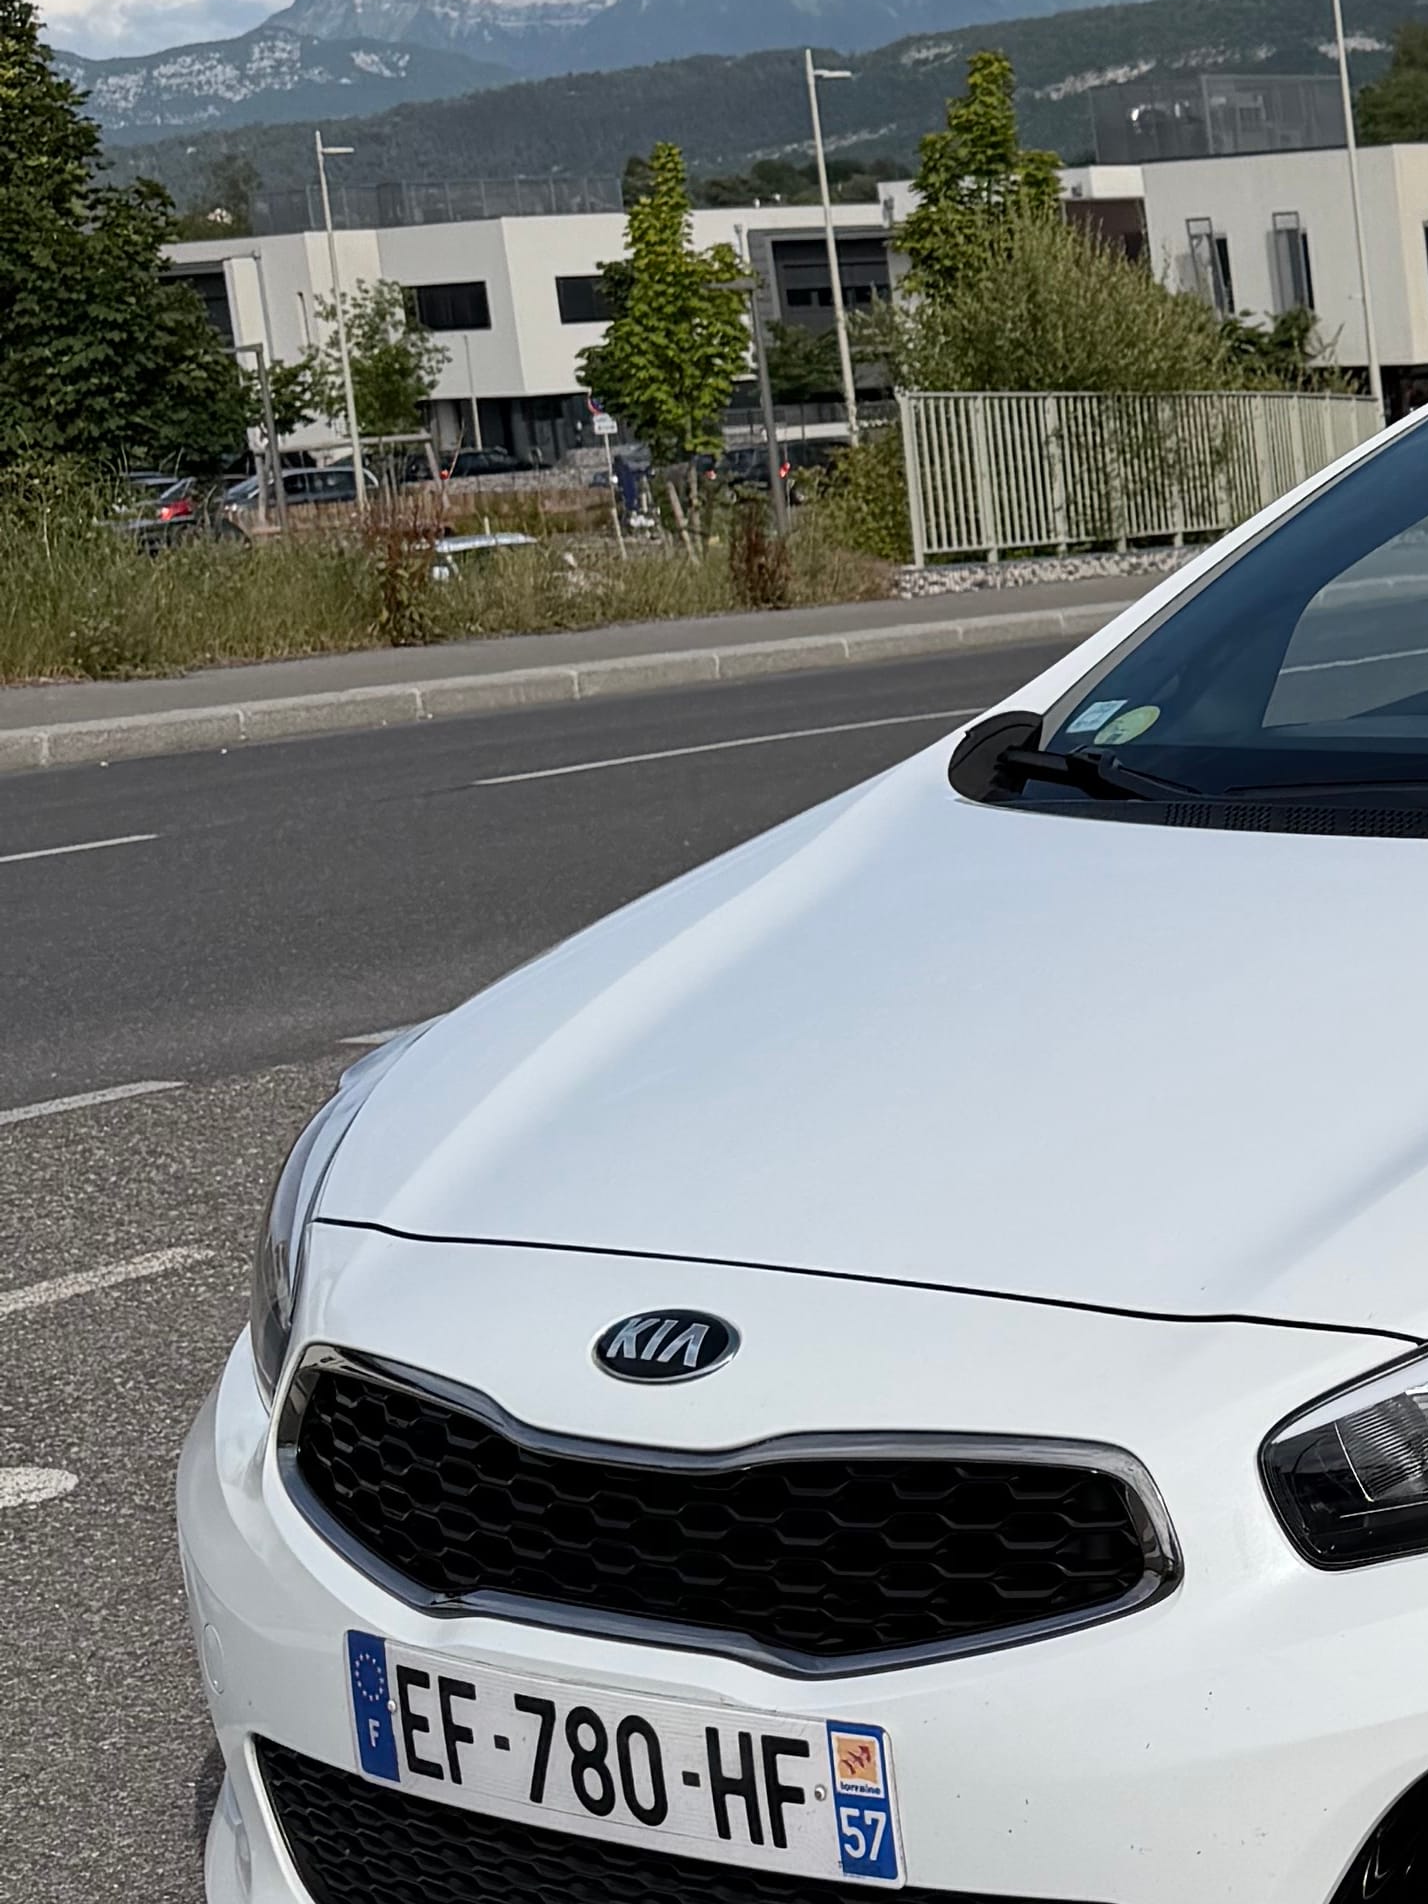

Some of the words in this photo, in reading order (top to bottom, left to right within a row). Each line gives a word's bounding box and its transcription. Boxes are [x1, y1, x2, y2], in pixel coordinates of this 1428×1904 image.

[606, 1317, 710, 1367] KIA
[368, 1718, 380, 1747] F
[396, 1664, 811, 1849] EF-780-HF
[839, 1806, 887, 1861] 57
